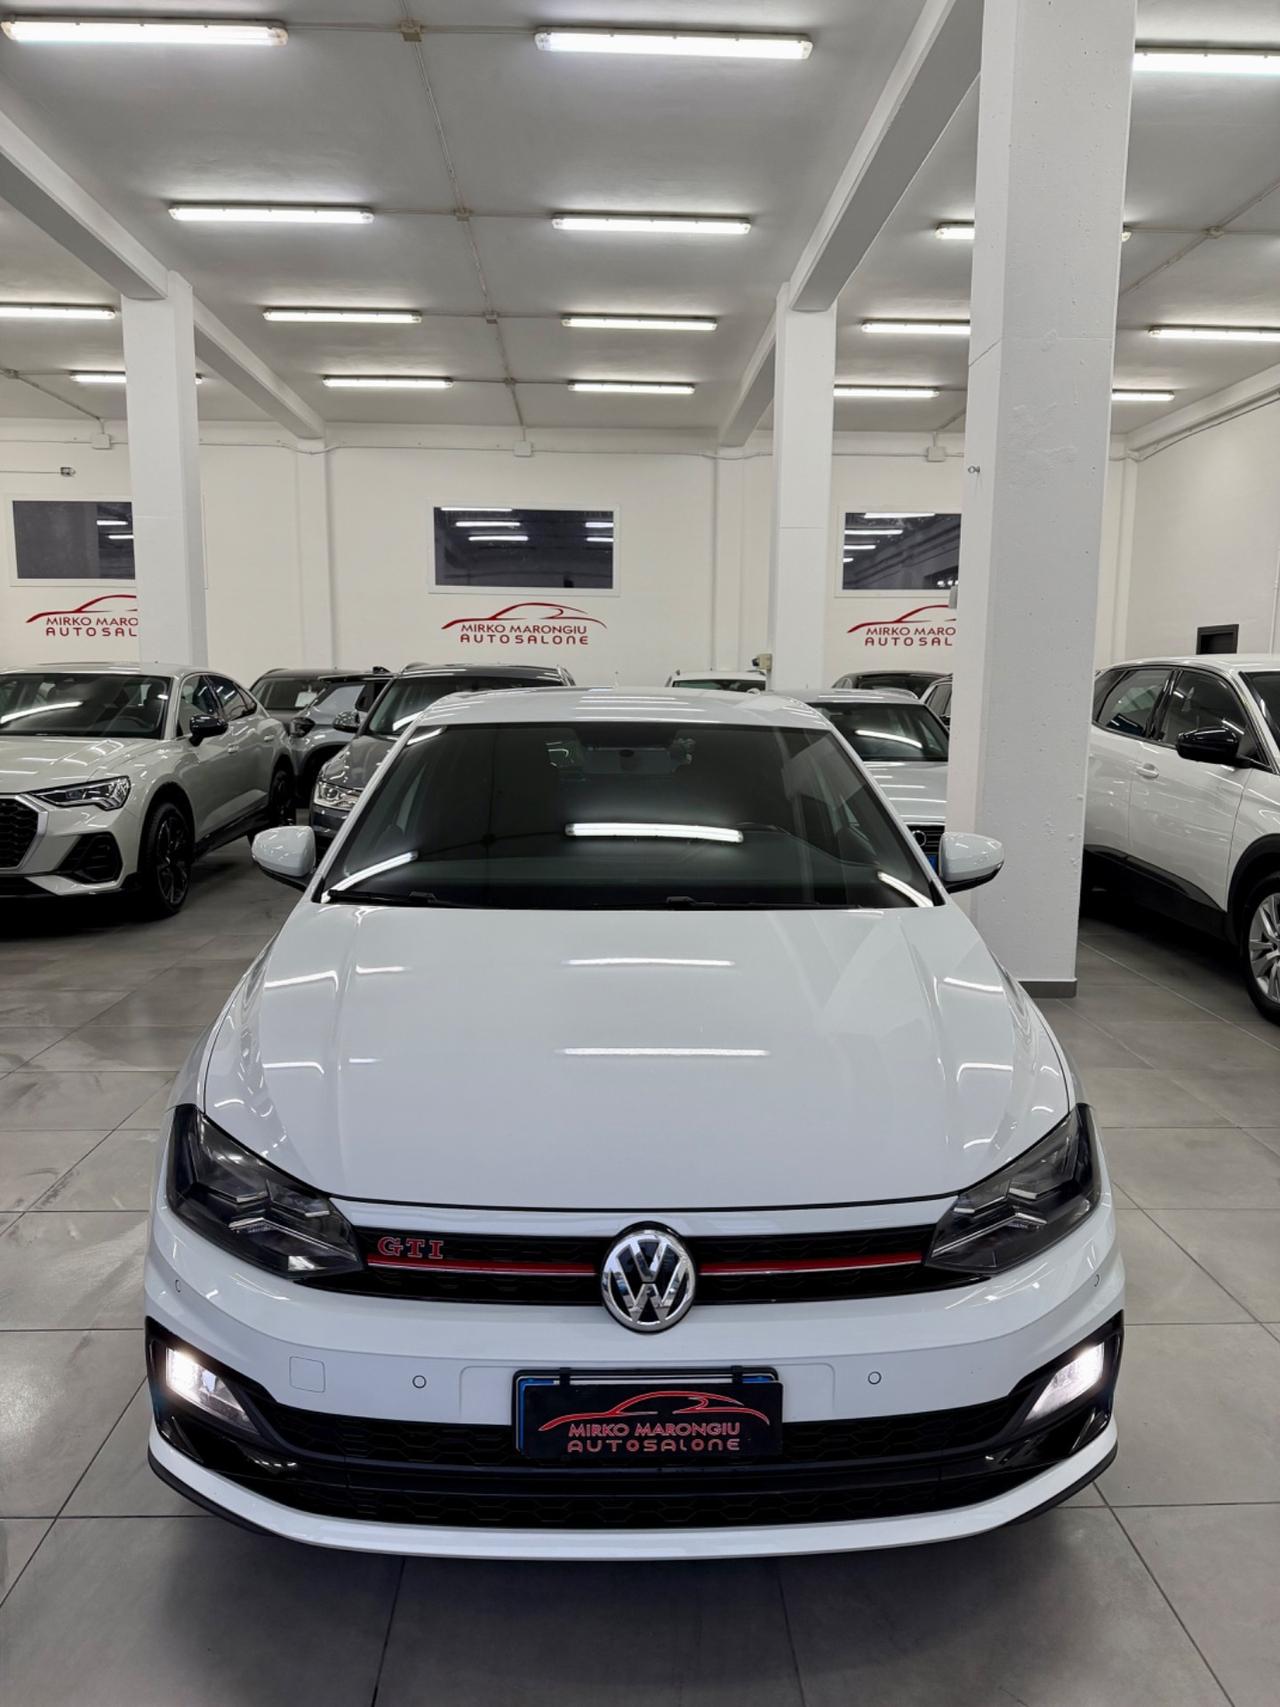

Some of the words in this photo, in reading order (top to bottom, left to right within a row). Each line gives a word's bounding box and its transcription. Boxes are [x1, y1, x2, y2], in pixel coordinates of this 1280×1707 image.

[46, 616, 92, 626] MIRKO
[461, 624, 506, 633] MIRKO
[509, 624, 588, 634] MARONGIU
[866, 627, 910, 636] MIRKO
[460, 634, 589, 645] AUTOSALONE
[377, 1236, 445, 1259] GTI
[568, 1422, 630, 1438] MIRKO
[634, 1422, 741, 1437] MARONGIU
[567, 1438, 740, 1453] AUTOSALONE
